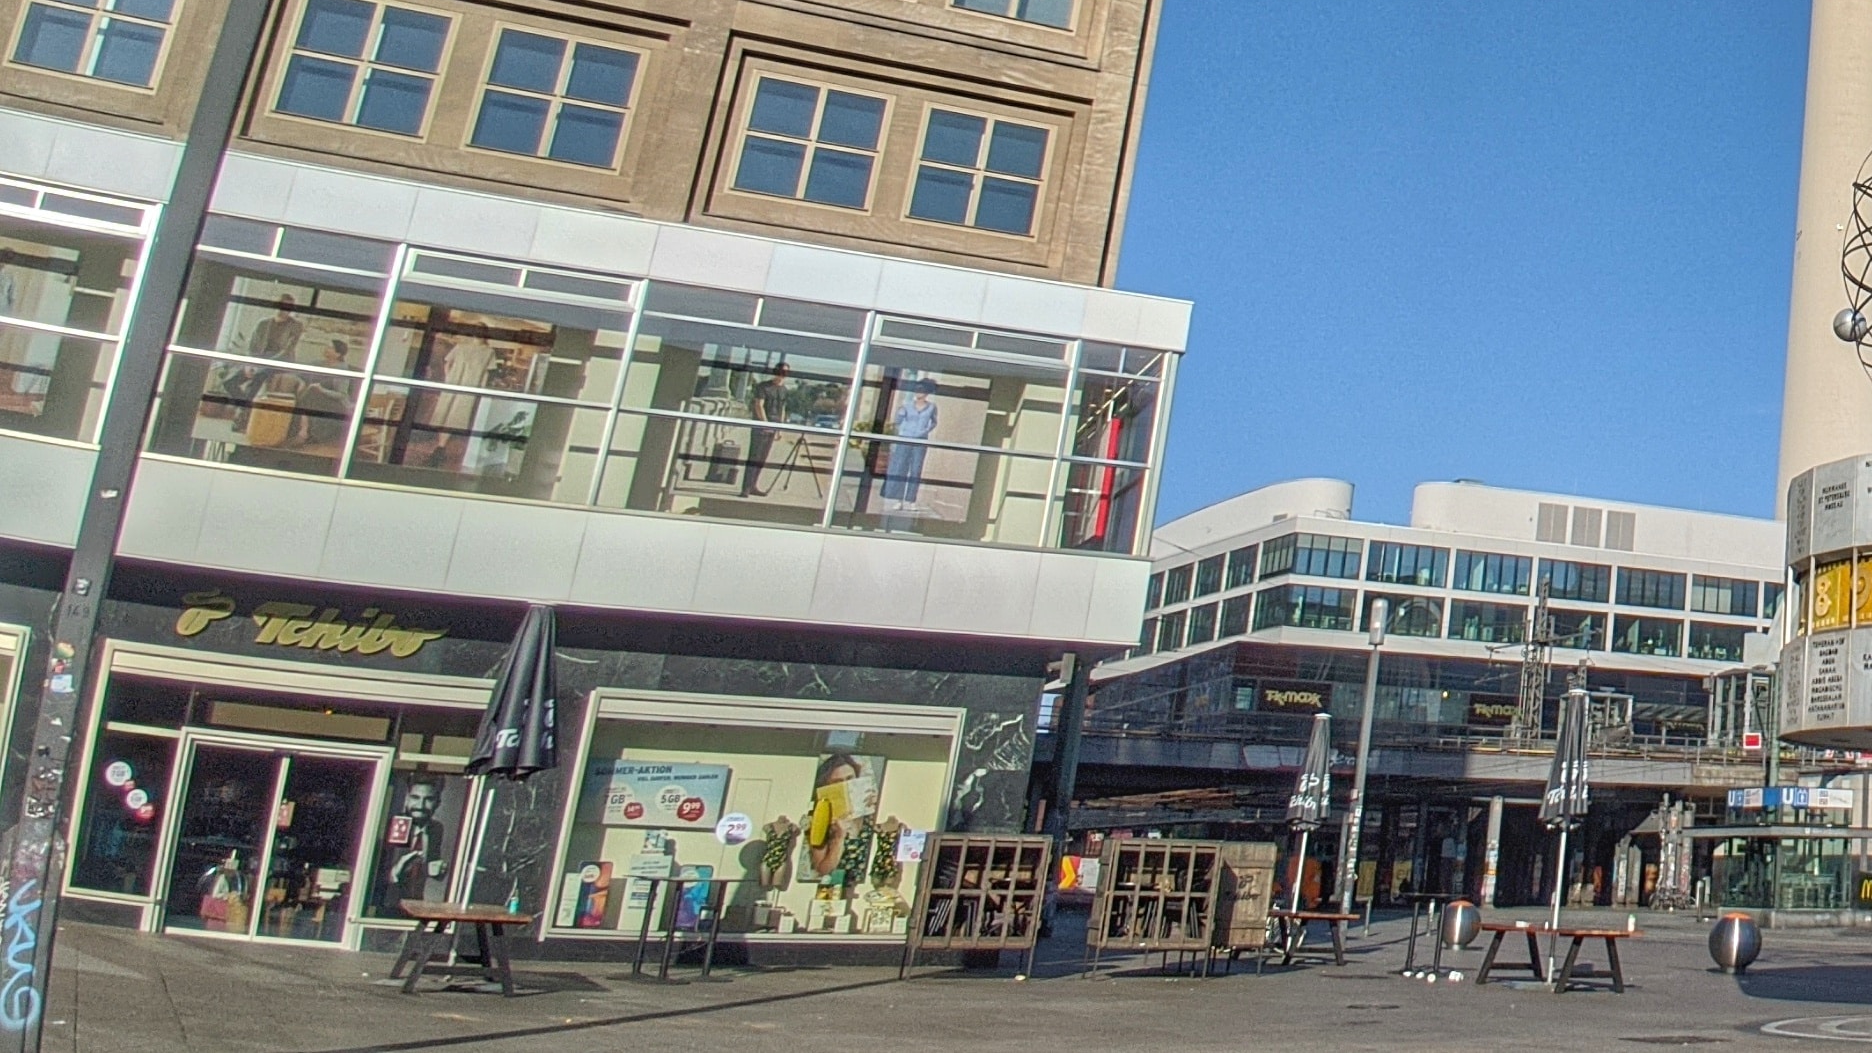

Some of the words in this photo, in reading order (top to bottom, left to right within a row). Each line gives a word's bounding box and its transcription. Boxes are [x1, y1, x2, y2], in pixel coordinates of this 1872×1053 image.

[1814, 577, 1833, 617] 8
[252, 601, 448, 657] Tchibo
[1728, 790, 1736, 806] U
[1782, 787, 1794, 804] U
